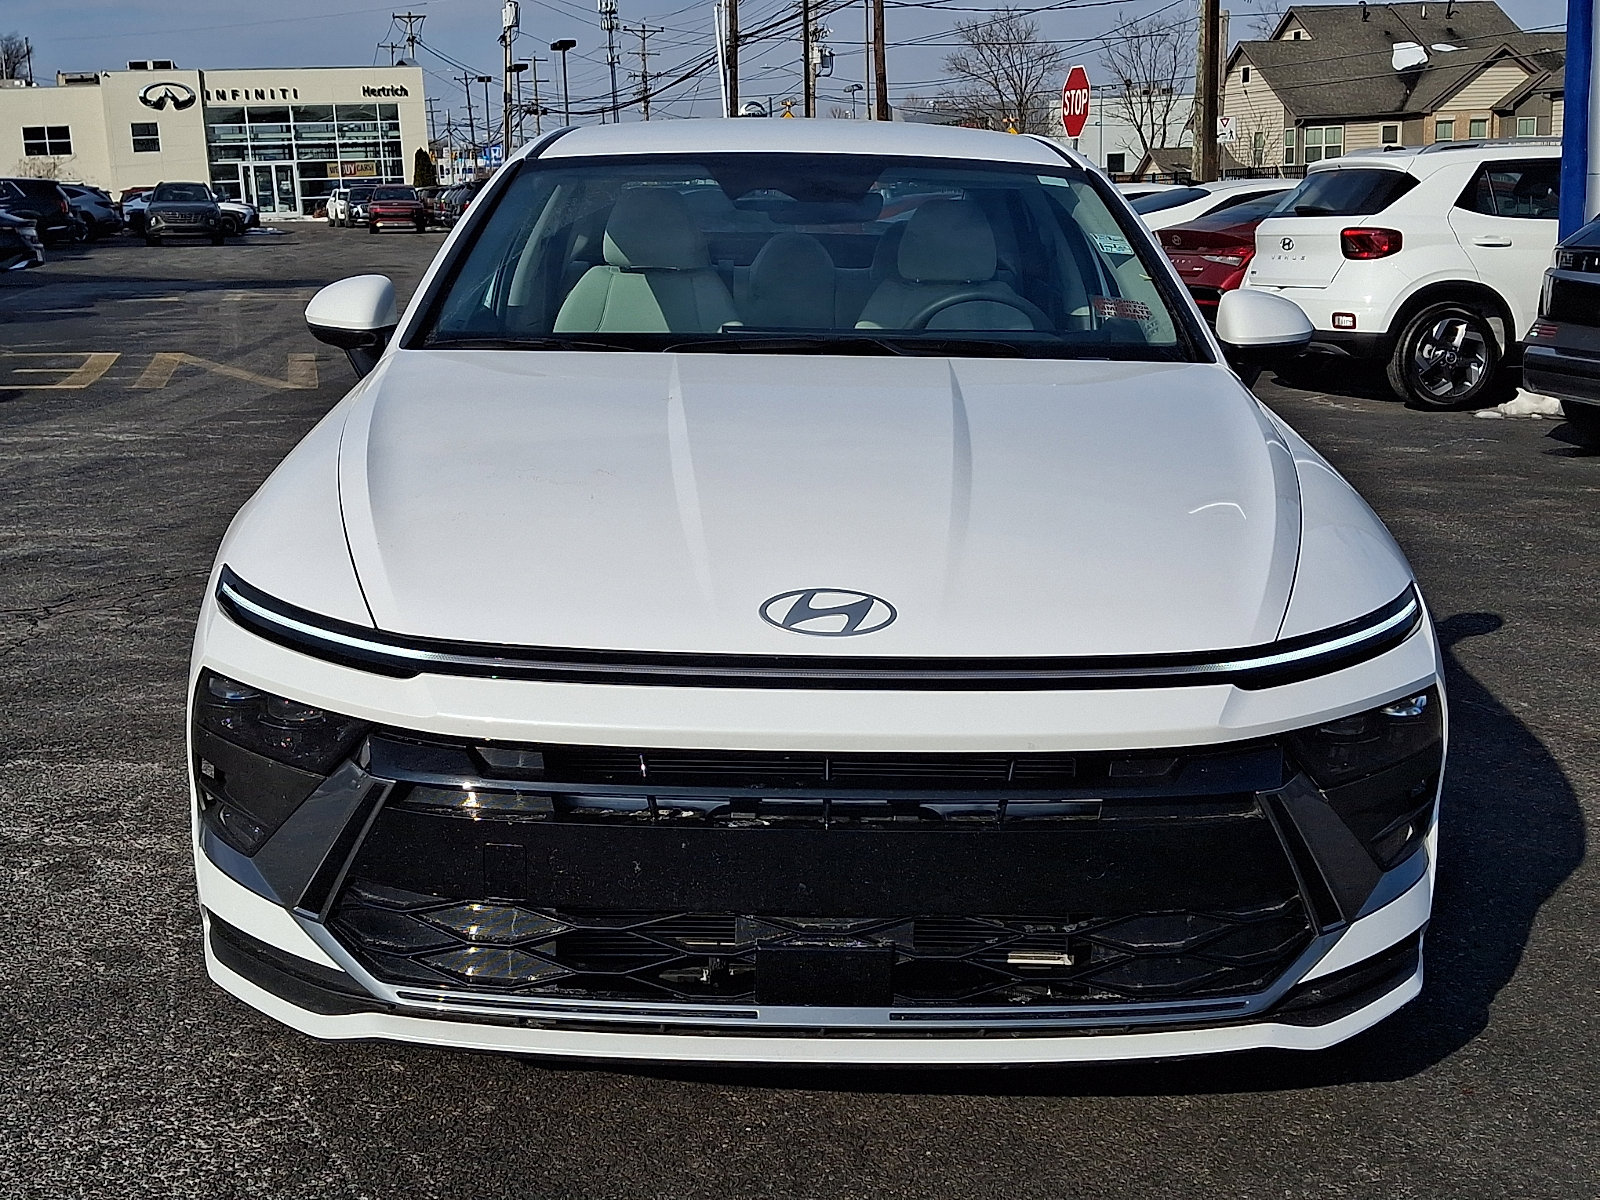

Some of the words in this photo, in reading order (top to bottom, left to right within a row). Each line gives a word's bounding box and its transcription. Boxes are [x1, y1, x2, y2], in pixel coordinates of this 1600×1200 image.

[205, 87, 298, 101] INFINITI
[362, 85, 409, 97] Hertrich
[1064, 89, 1088, 116] STOP
